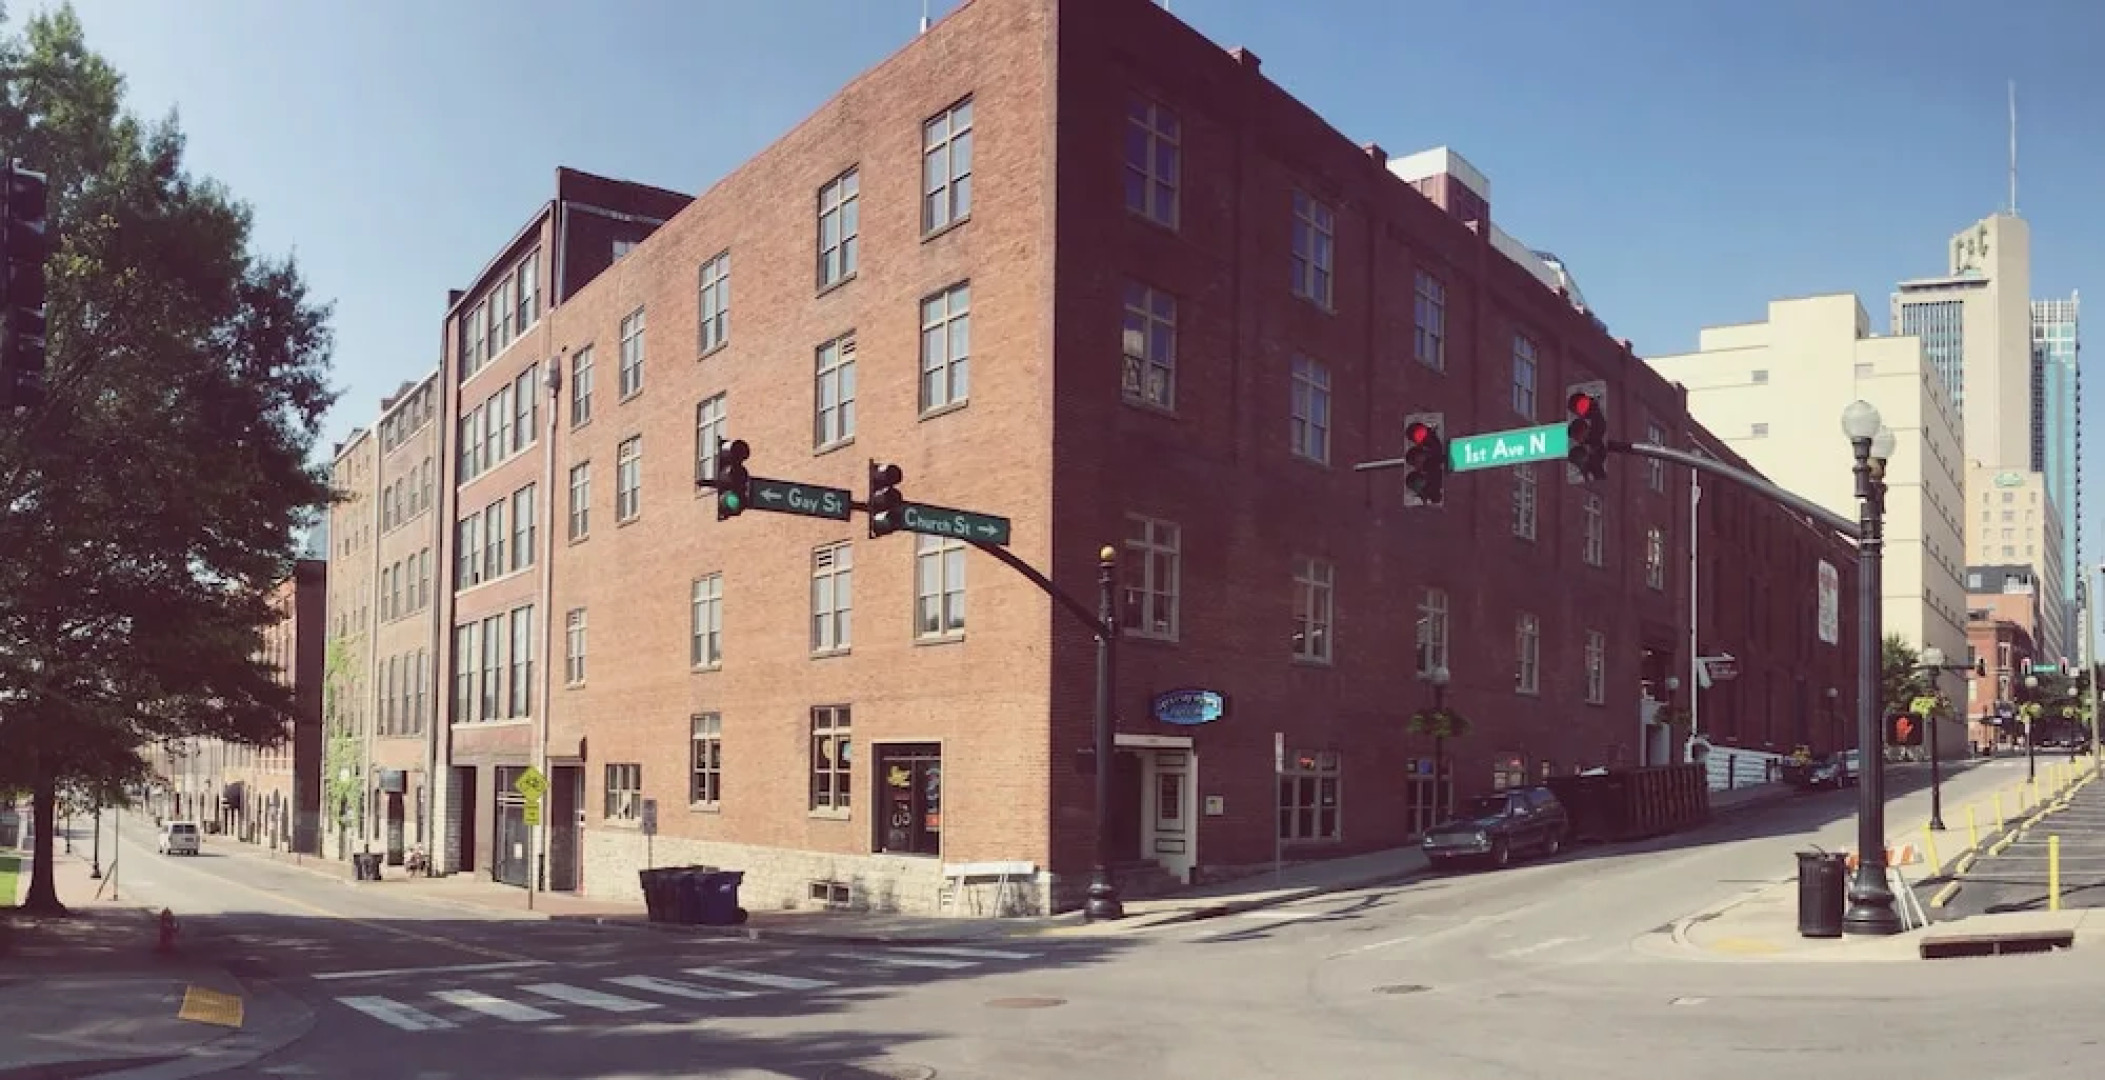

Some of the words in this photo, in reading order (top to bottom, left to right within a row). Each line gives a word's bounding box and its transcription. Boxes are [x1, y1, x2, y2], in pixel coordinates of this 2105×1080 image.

[1465, 443, 1486, 463] 1st
[1492, 438, 1524, 459] Ave
[1530, 432, 1546, 455] N
[789, 488, 819, 513] Gay
[823, 493, 842, 514] St
[905, 508, 954, 532] Church
[955, 516, 971, 535] St
